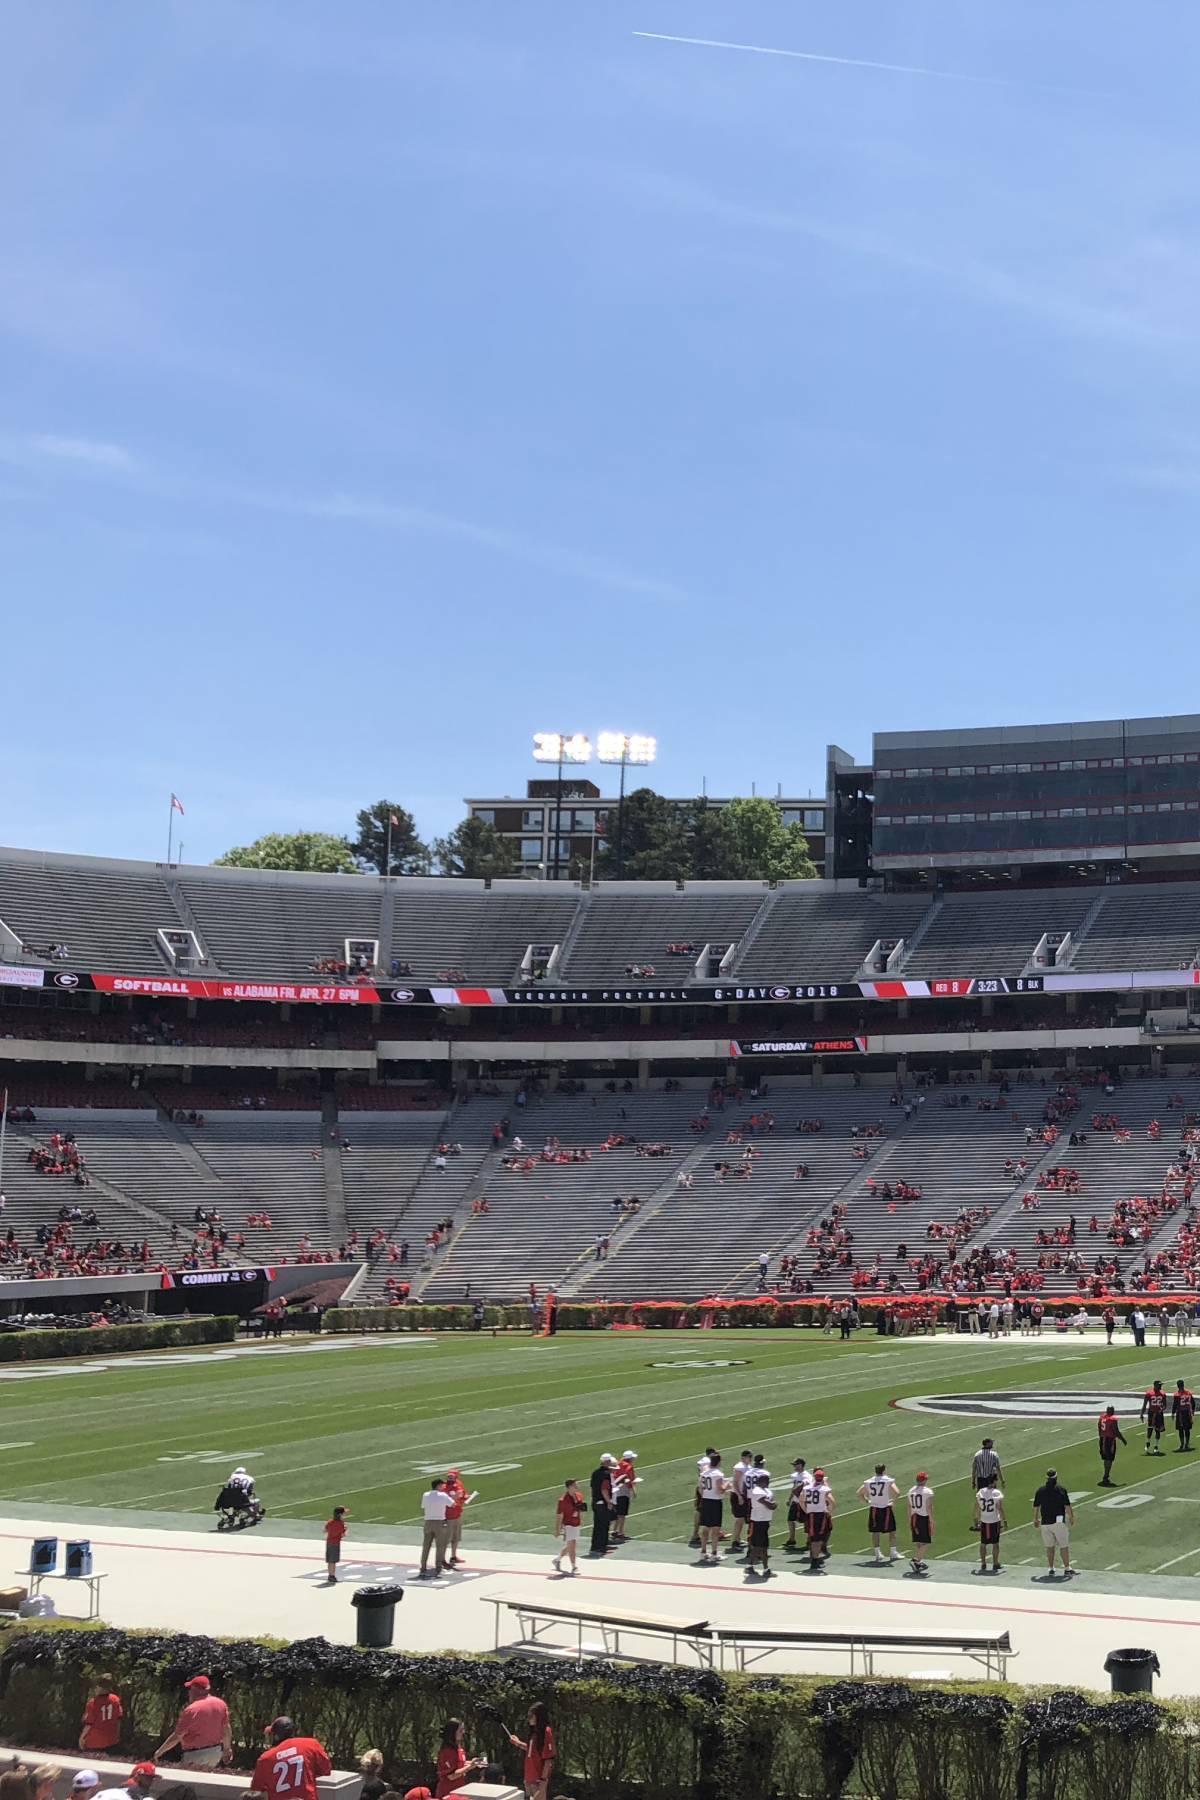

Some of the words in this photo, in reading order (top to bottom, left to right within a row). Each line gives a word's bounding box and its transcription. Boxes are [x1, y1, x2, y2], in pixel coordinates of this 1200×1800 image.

[113, 979, 189, 993] SOFTBALL
[234, 985, 278, 998] ALABAMA
[322, 988, 336, 999] 27
[338, 989, 360, 1001] 6PM
[952, 981, 959, 992] 8
[978, 981, 998, 992] 3:23
[1016, 979, 1023, 990] 8
[1028, 980, 1039, 989] BLK
[514, 992, 588, 1000] GEORGIA
[602, 991, 688, 1000] FOOTBALL
[714, 988, 766, 999] G-DAY
[795, 986, 837, 998] 2018
[751, 1042, 807, 1052] SATURDAY
[812, 1040, 854, 1050] ATHENS
[182, 1273, 230, 1285] COMMIT
[1150, 1396, 1162, 1406] 22
[869, 1481, 886, 1497] 57
[805, 1490, 820, 1505] 28
[910, 1494, 923, 1509] 10
[979, 1498, 995, 1513] 32
[100, 1703, 113, 1721] 11
[273, 1754, 304, 1793] 27
